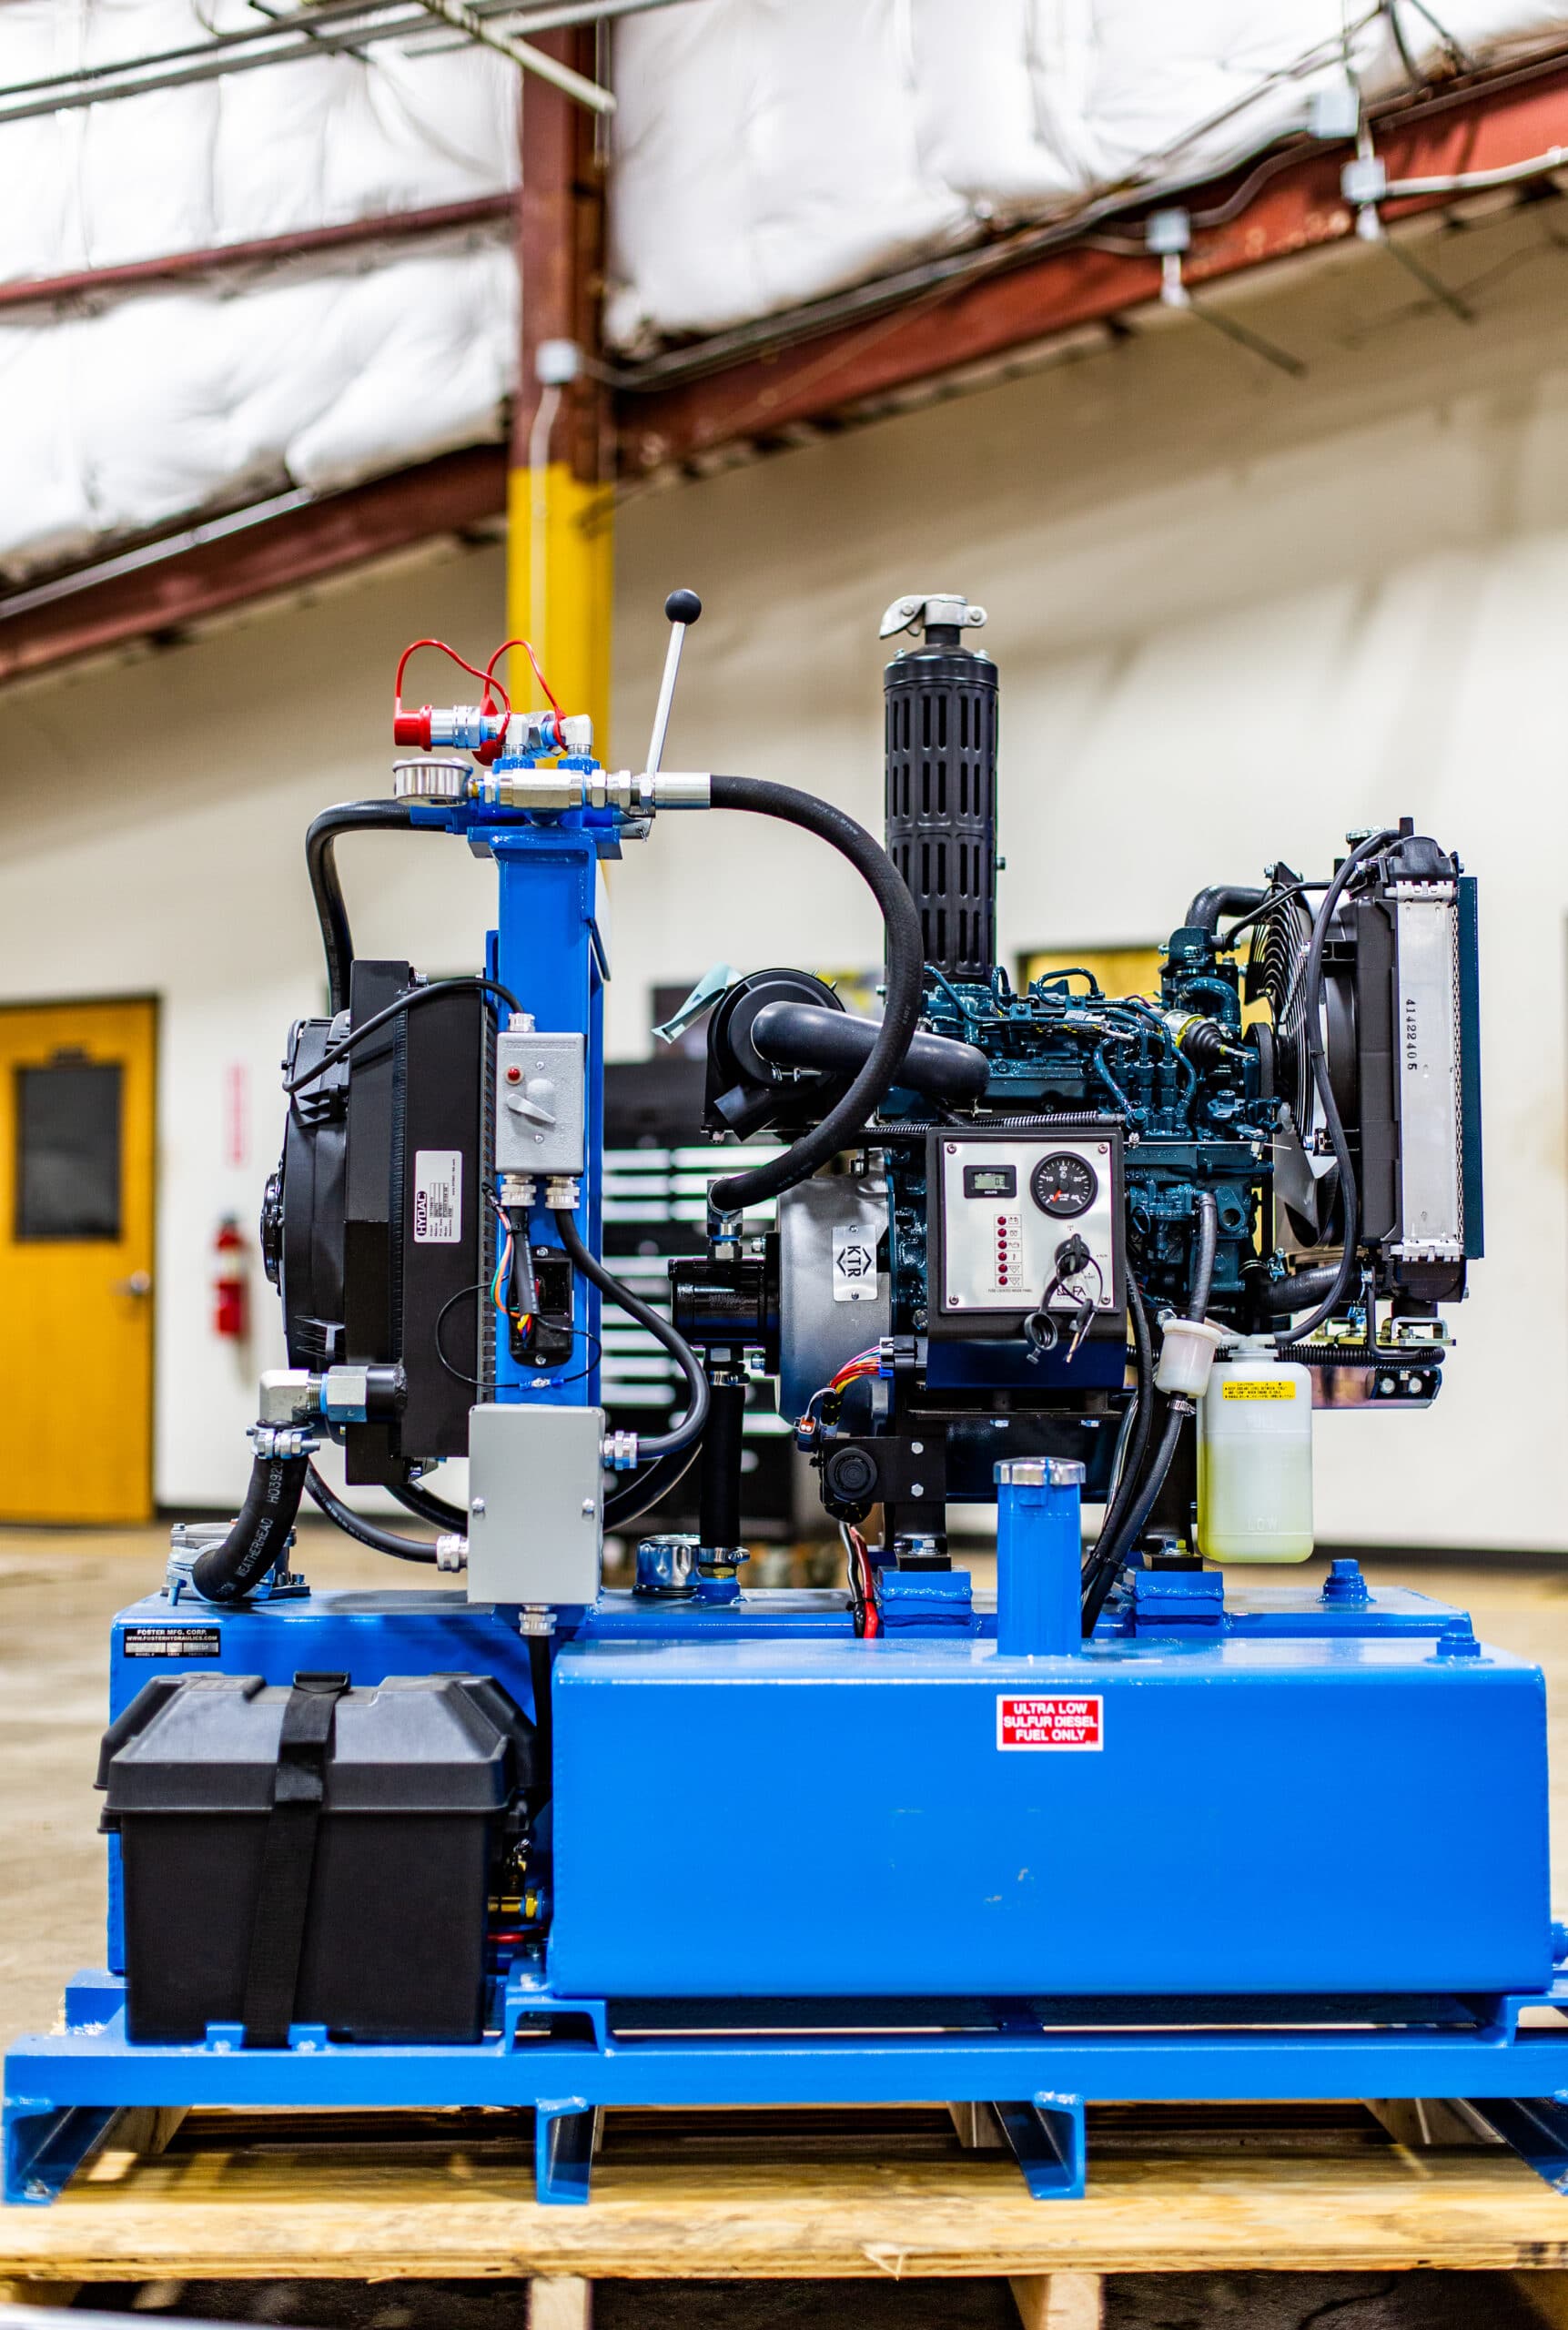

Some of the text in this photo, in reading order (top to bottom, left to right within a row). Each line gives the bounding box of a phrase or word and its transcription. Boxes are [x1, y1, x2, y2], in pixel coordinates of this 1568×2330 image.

[417, 1192, 427, 1235] HYDAC
[847, 1246, 861, 1278] KTR
[237, 1517, 274, 1577] WEATHERHEAD
[1013, 1702, 1088, 1715] ULTRA LOW
[1003, 1716, 1098, 1728] SULFUR DIESEL
[1015, 1728, 1087, 1741] FUEL ONLY
